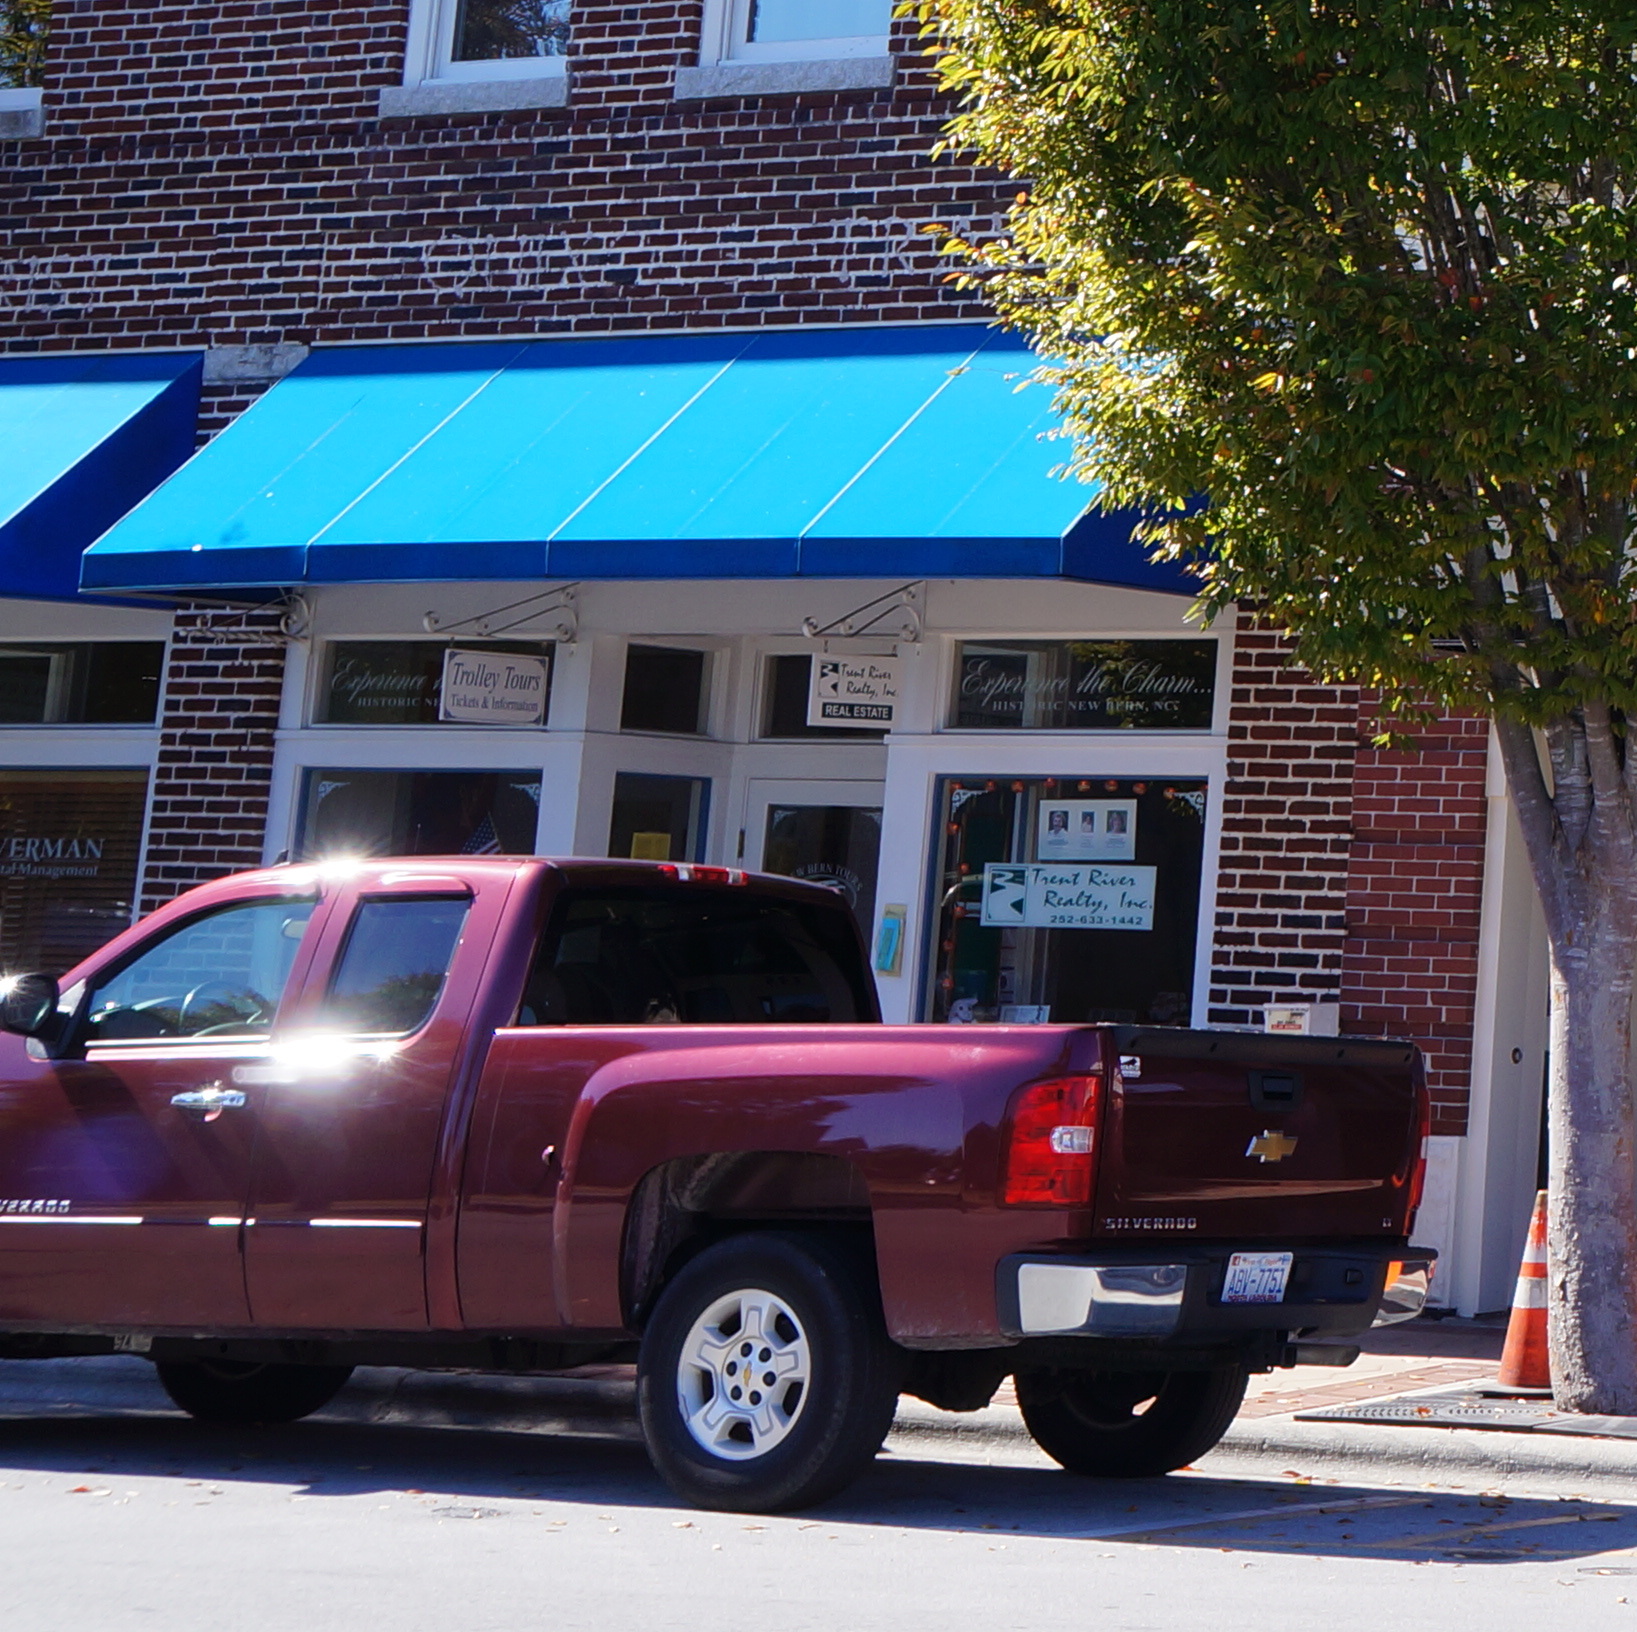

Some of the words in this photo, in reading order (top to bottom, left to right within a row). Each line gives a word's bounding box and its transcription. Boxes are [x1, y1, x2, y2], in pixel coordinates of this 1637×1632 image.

[332, 656, 428, 704] Experience
[452, 662, 500, 694] Trolley
[504, 666, 541, 691] Tours
[841, 663, 866, 678] Trent
[868, 665, 892, 680] River
[846, 681, 878, 700] Realty,
[962, 658, 1070, 706] Experience
[1076, 663, 1109, 694] the
[358, 697, 421, 707] HISTORIC
[451, 694, 479, 708] Tickets
[481, 696, 489, 709] &
[492, 696, 539, 712] Information
[992, 701, 1064, 711] HISTRIC
[1068, 701, 1101, 711] NEW
[825, 704, 852, 717] REAL
[853, 705, 889, 718] ESTATE
[19, 863, 99, 880] Management
[1032, 868, 1080, 887] Trent
[1088, 869, 1136, 887] River
[1043, 890, 1108, 913] Realty,
[1120, 891, 1153, 909] Inc.
[1050, 914, 1143, 926] 252-633-1442
[1105, 1217, 1198, 1230] SILVERADO
